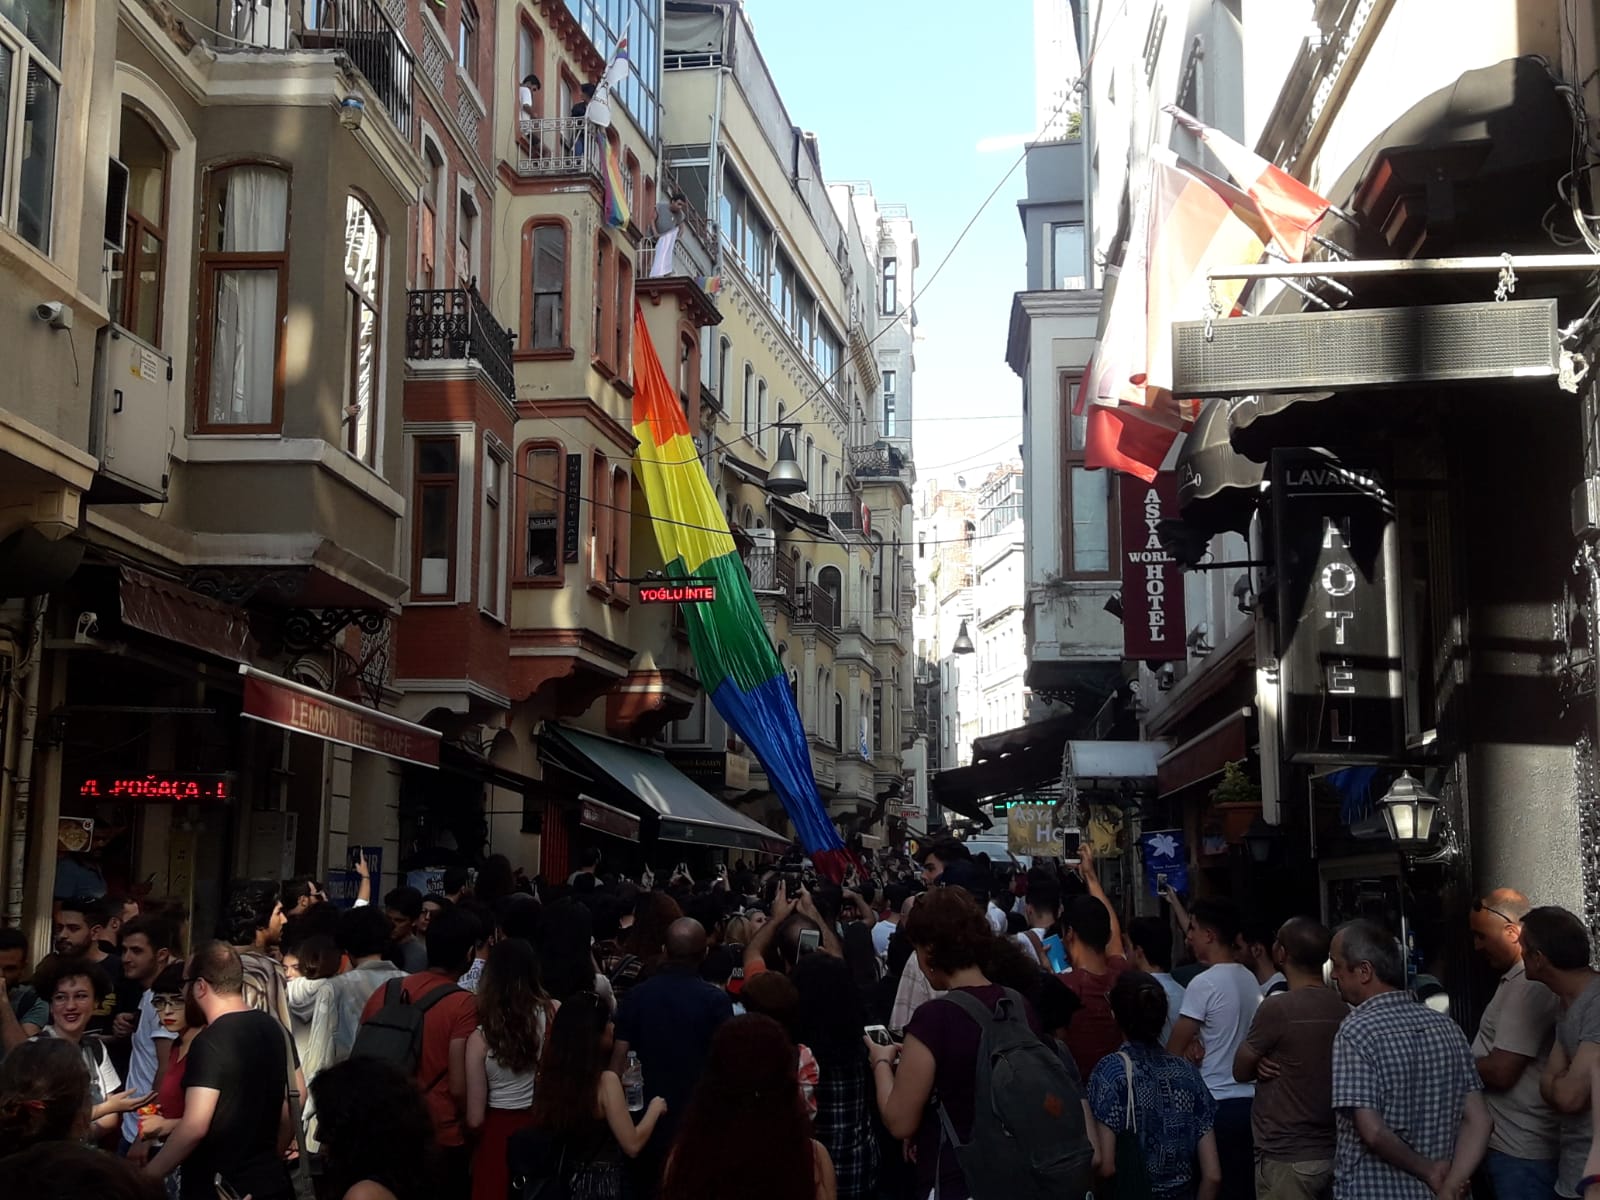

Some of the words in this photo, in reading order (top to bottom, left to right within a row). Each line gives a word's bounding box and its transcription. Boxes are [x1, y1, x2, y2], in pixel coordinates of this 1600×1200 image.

[1144, 488, 1163, 549] ASYA
[1128, 551, 1177, 563] WORL
[1145, 564, 1165, 641] HOTEL
[290, 698, 339, 737] LEMON
[349, 716, 377, 748] TREE
[383, 730, 411, 757] CAFE
